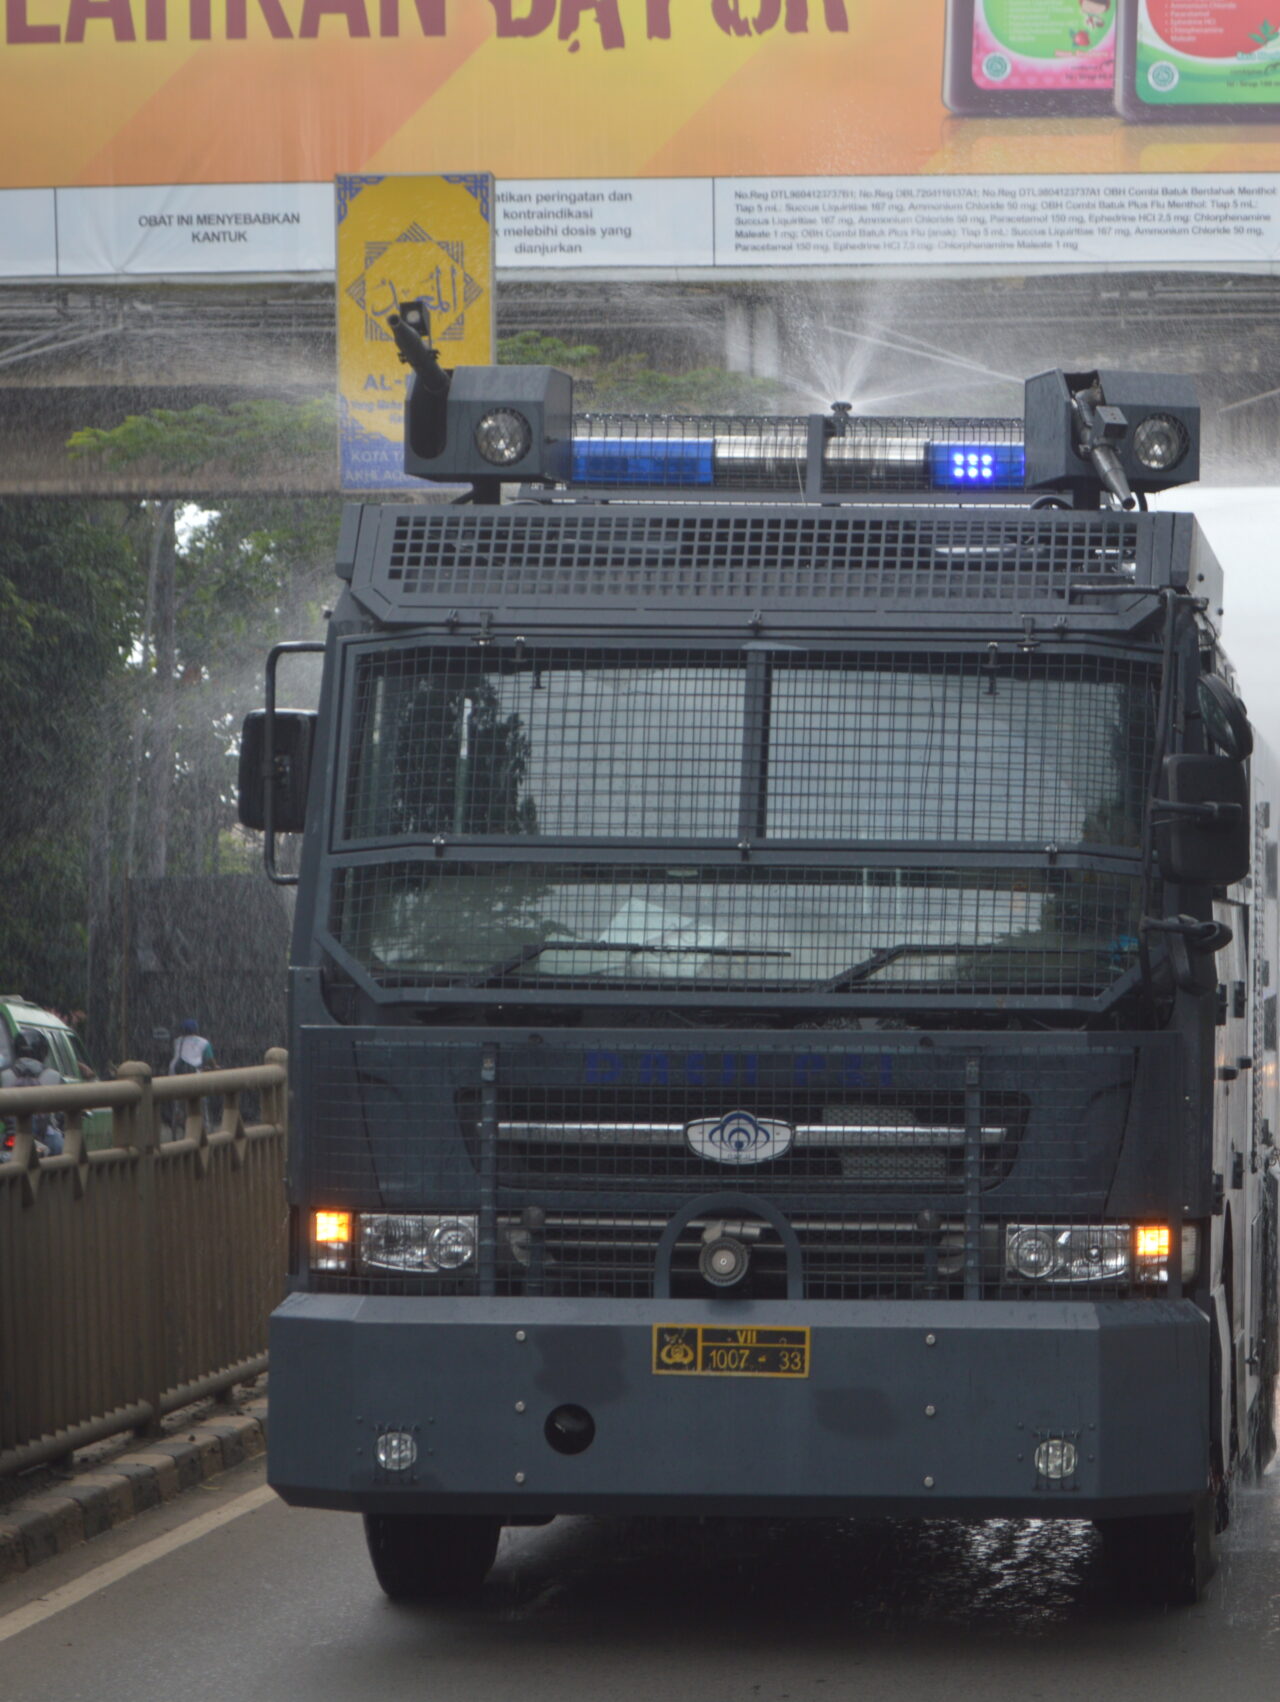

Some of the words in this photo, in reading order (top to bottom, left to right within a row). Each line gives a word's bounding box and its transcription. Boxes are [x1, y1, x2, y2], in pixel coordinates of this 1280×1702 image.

[536, 190, 604, 204] peringatan
[608, 190, 632, 202] dan
[138, 213, 174, 228] OBAT
[176, 212, 193, 226] INI
[196, 211, 300, 226] MENYEBABKAN
[503, 208, 593, 220] kontraindikasi
[191, 230, 248, 243] KANTUK
[504, 226, 558, 238] melebihi
[561, 225, 596, 238] dosis
[600, 226, 632, 239] yang
[514, 243, 582, 257] dianjurkan
[736, 1329, 756, 1344] VII
[710, 1348, 750, 1370] 1007
[778, 1351, 802, 1370] 33
